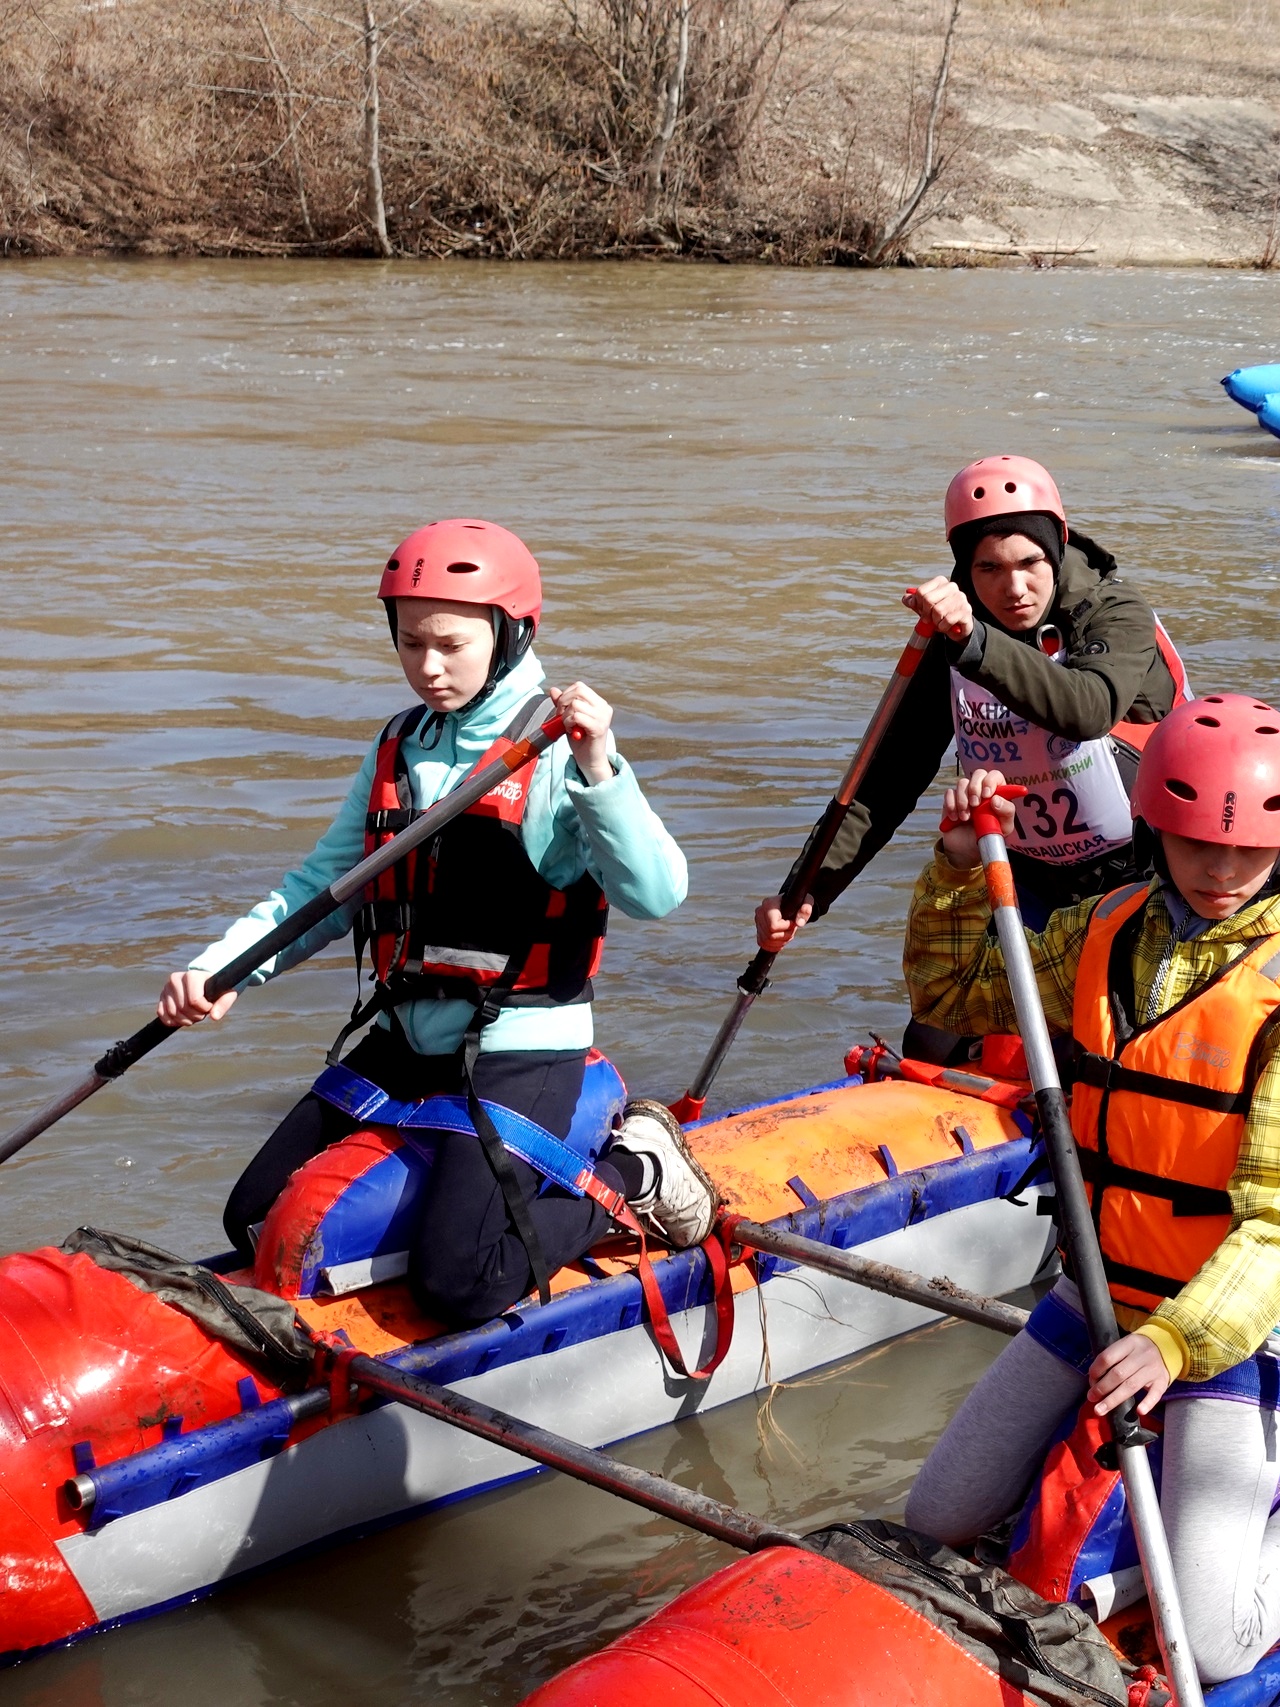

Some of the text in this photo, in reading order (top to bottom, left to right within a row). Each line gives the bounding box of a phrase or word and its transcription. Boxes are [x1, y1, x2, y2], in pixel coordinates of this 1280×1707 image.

[412, 558, 424, 588] RST
[960, 736, 1023, 763] 2022
[1050, 755, 1094, 782] ЖИЗНИ
[1221, 791, 1236, 832] RST
